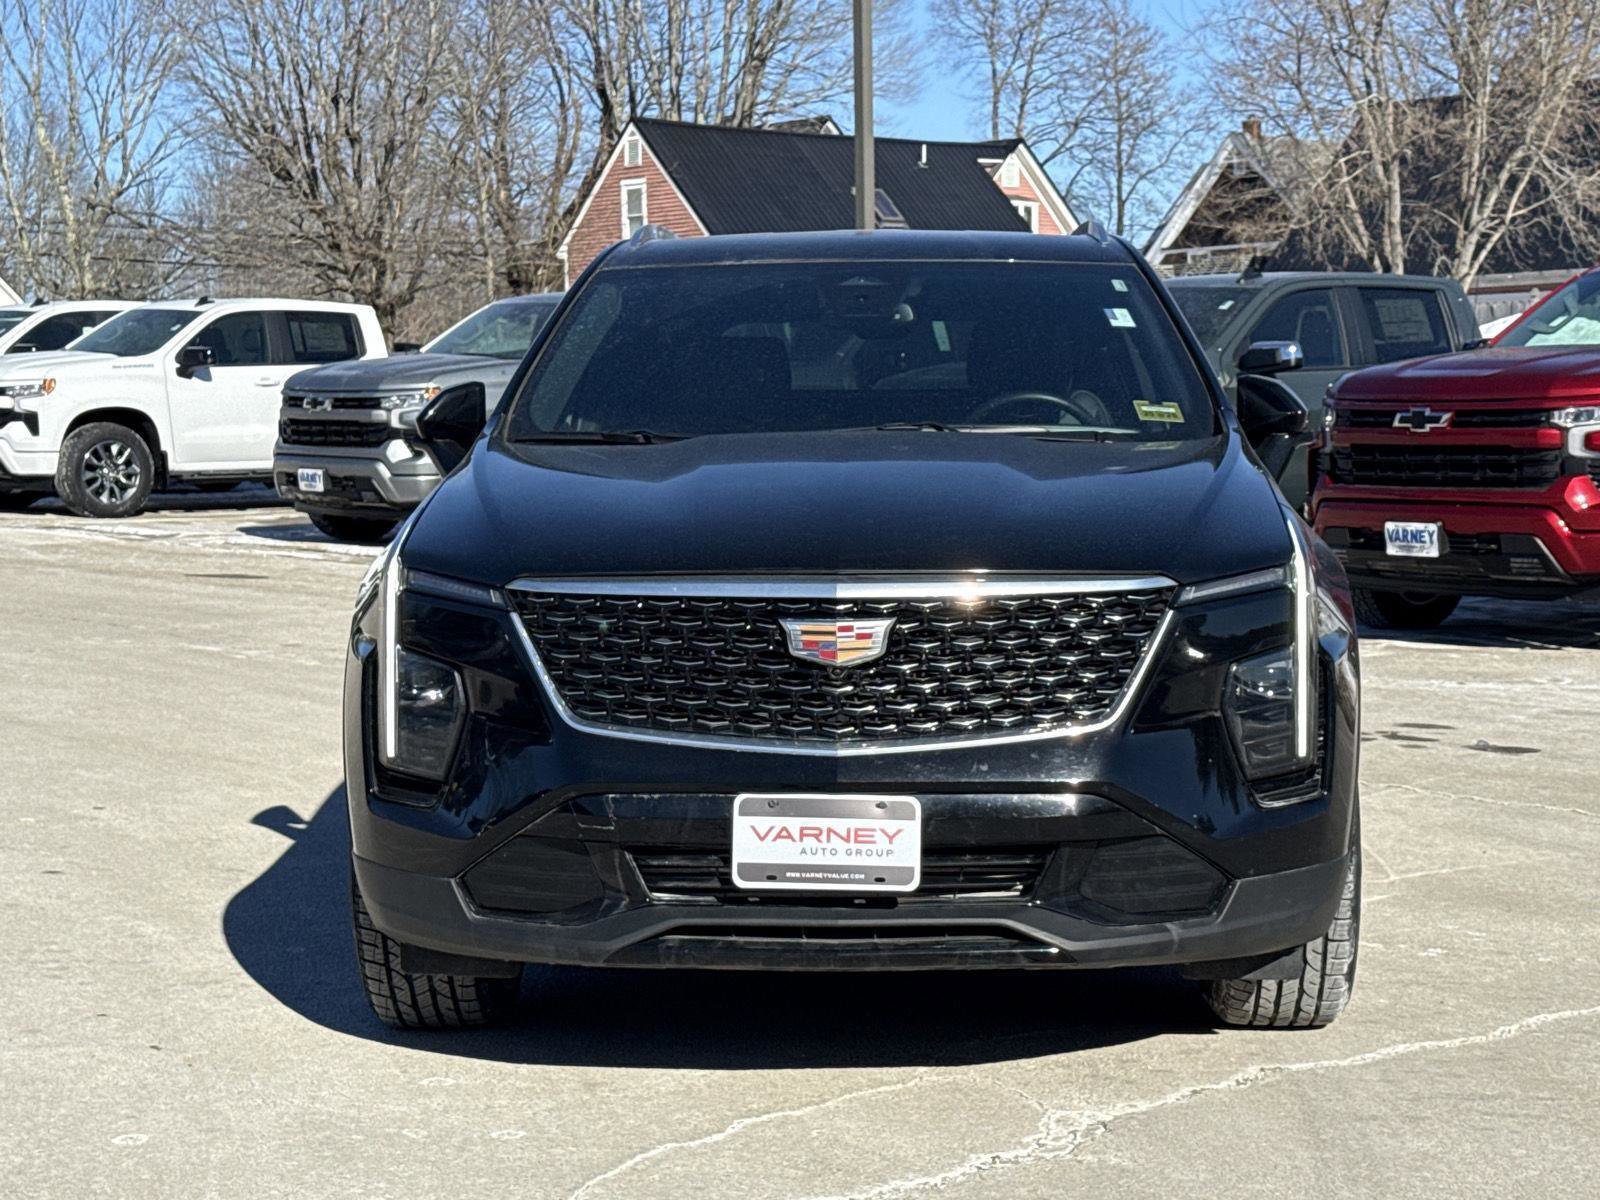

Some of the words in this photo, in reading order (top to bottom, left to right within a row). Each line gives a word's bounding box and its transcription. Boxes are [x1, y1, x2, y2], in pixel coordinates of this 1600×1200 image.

[1387, 528, 1435, 544] VARNEY
[750, 825, 903, 844] VARNEY
[800, 847, 838, 856] AUTO
[845, 848, 894, 857] GROUP
[786, 872, 865, 880] WWW.VARNEYVALUE.COM
